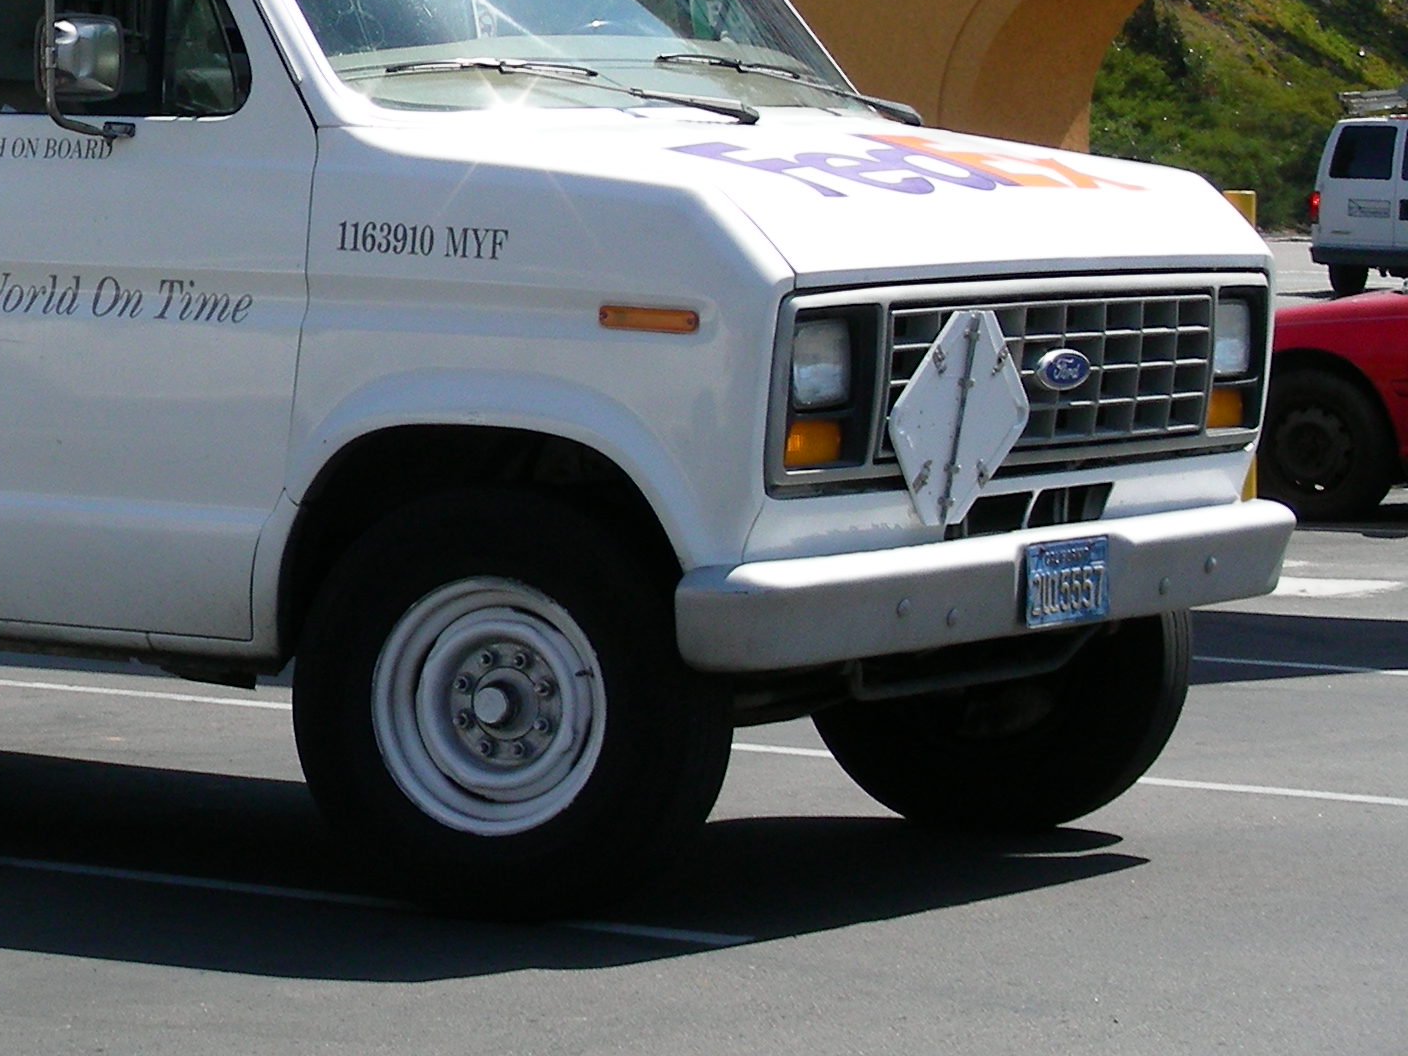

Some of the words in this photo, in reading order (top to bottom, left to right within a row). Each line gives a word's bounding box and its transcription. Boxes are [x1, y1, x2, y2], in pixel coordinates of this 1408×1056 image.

[11, 137, 40, 159] ON
[44, 137, 113, 160] BOARD
[665, 132, 1149, 198] FedEx
[336, 220, 434, 257] 1163910
[444, 226, 509, 260] MYF
[91, 276, 143, 319] On
[154, 279, 253, 324] Time
